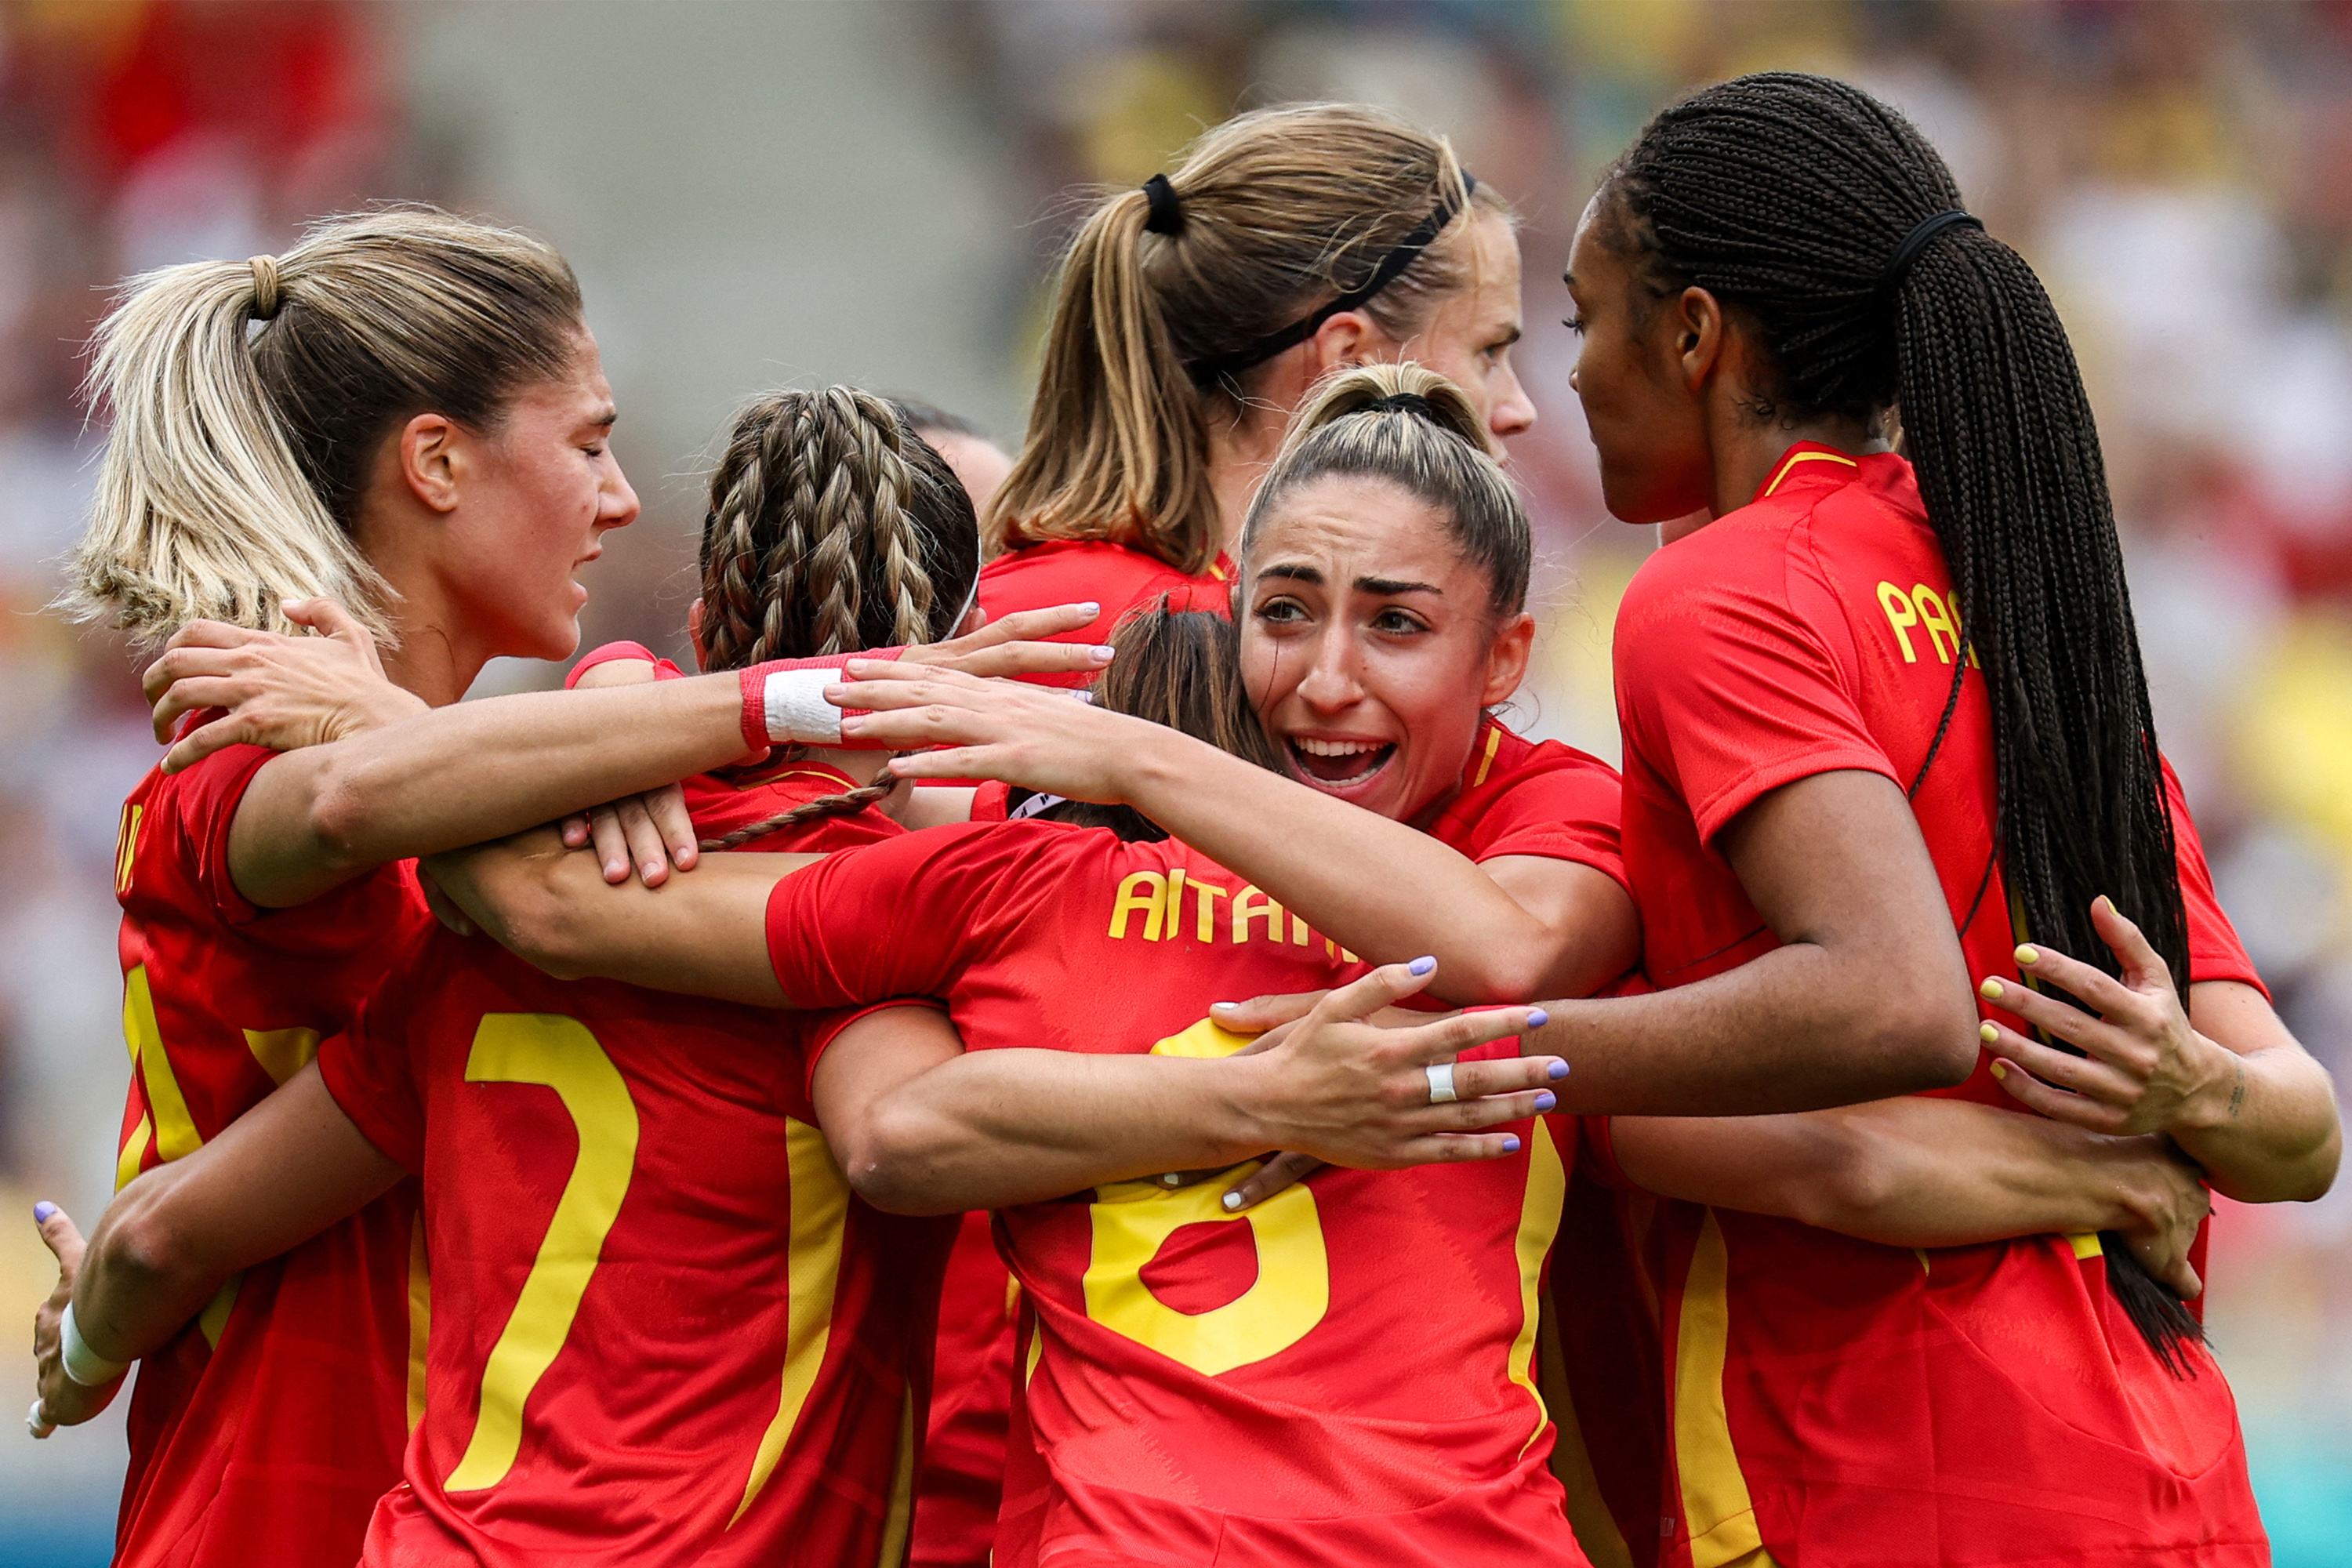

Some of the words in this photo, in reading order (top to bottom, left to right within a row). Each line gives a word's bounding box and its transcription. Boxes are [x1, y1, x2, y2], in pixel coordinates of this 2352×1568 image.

[1108, 868, 1359, 964] AITA
[444, 1012, 640, 1492] 7
[1083, 1017, 1330, 1377] 6
